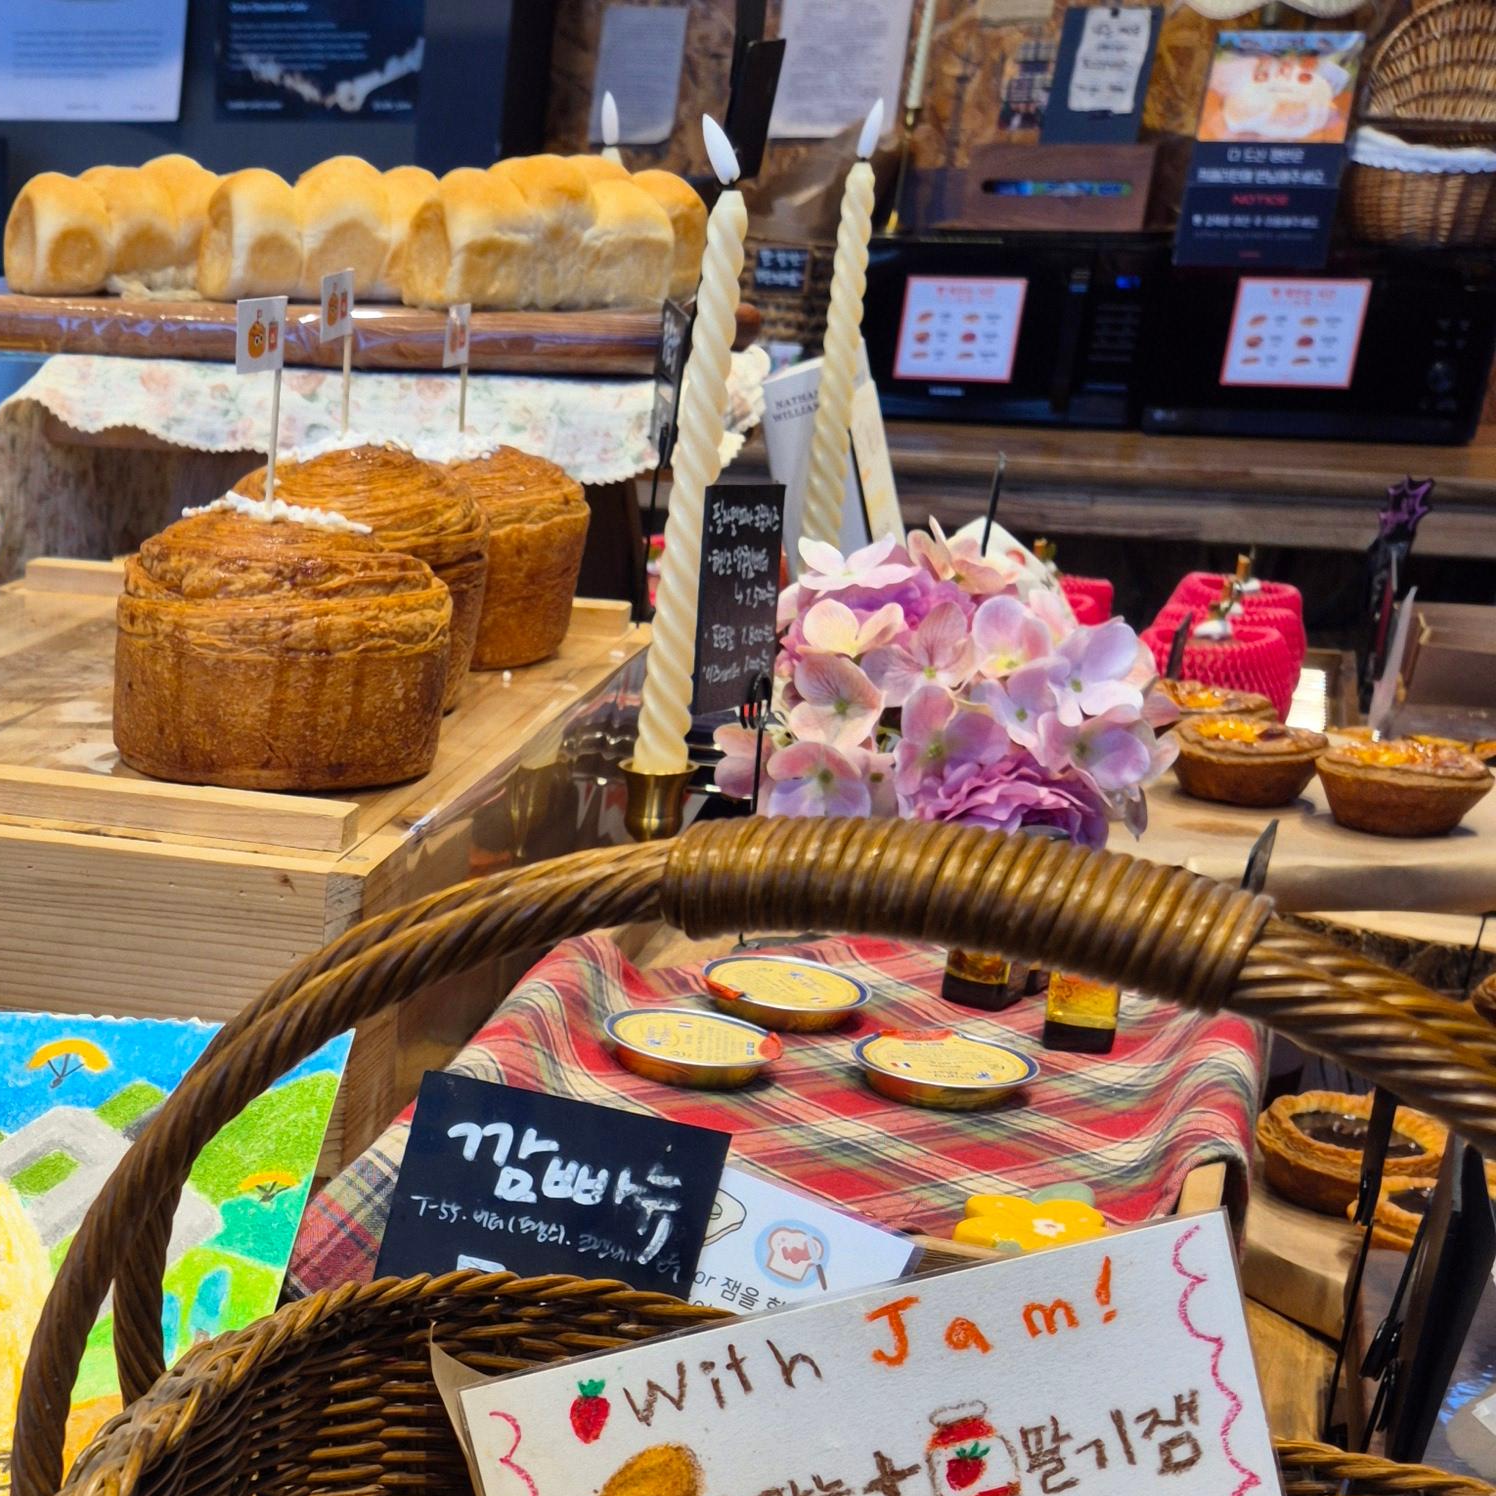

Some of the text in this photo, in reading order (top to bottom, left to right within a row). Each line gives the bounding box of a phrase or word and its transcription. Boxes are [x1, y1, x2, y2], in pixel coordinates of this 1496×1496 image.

[720, 1277, 760, 1311] 잼을
[865, 1254, 1119, 1368] Jam!
[1019, 1389, 1204, 1495] 딸기잼
